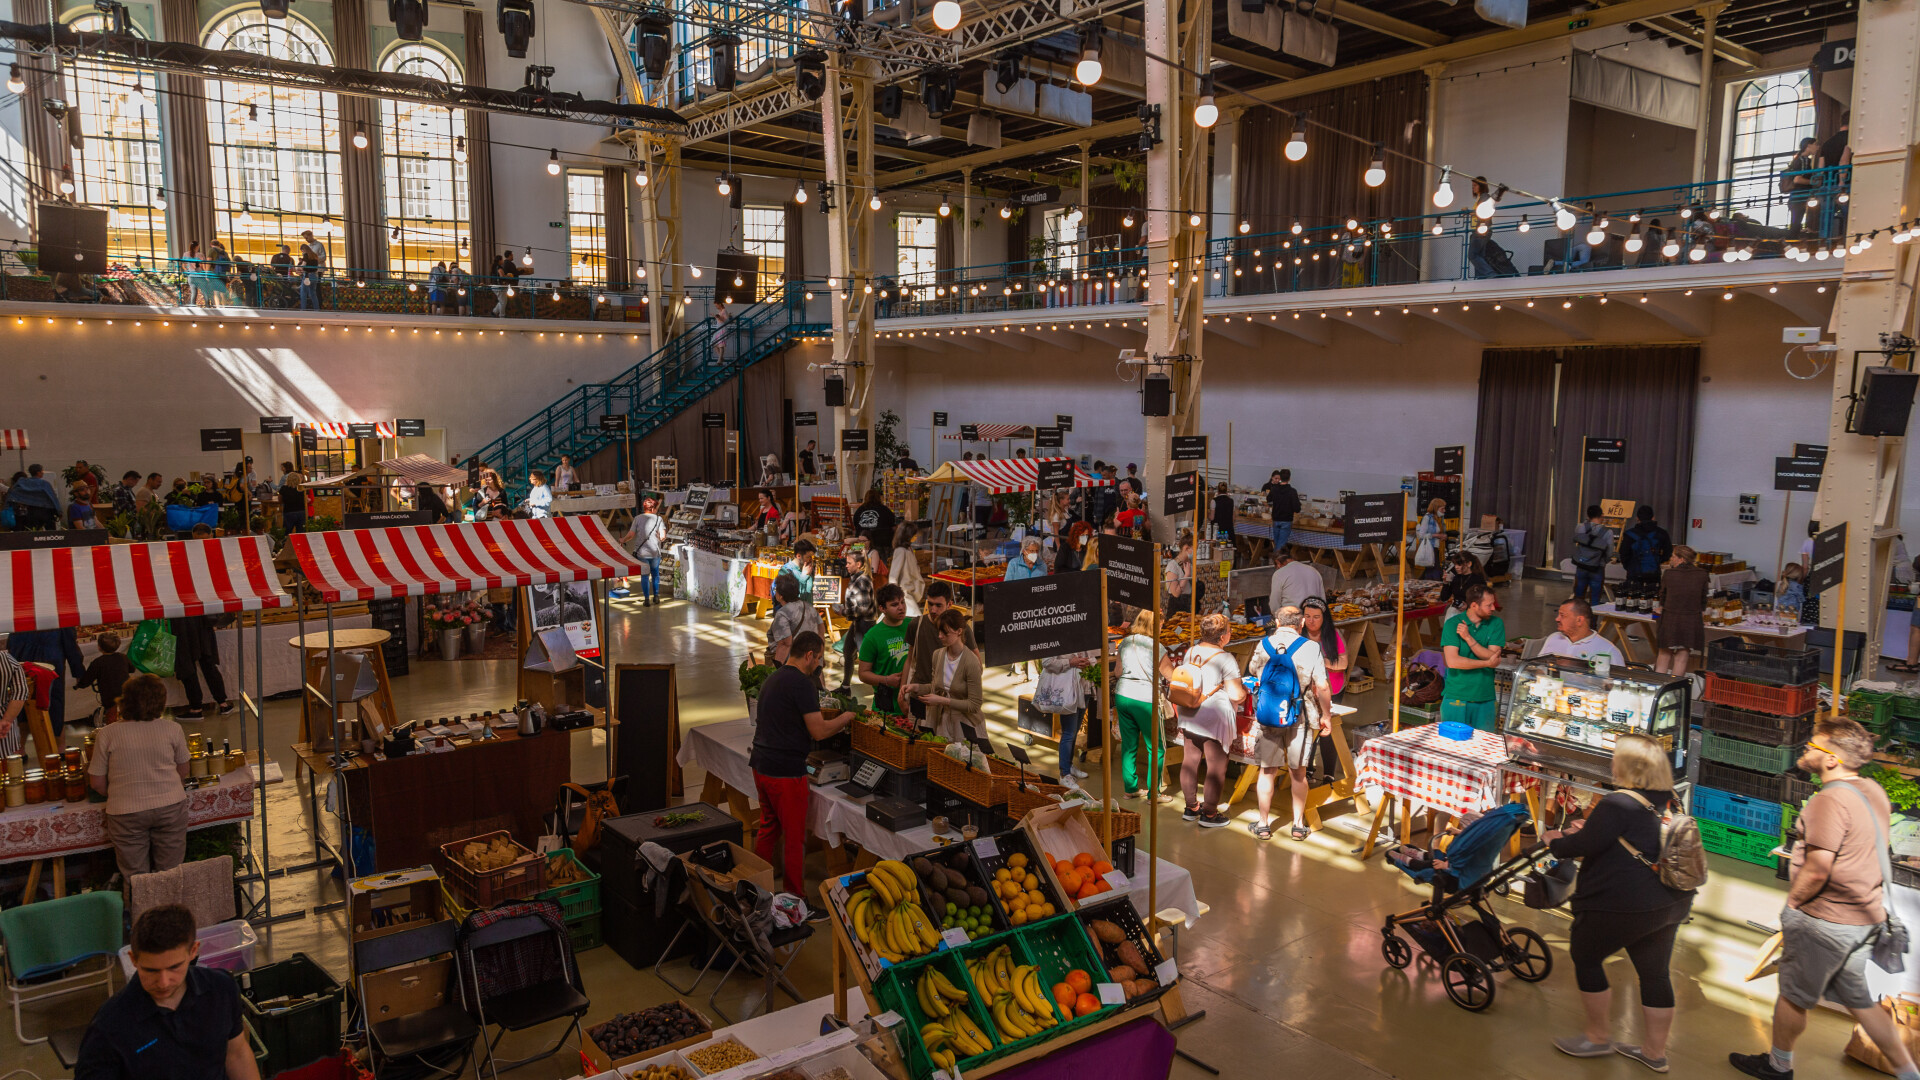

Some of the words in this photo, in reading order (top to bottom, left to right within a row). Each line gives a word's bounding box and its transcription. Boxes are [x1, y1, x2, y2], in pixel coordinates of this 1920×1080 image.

[1608, 507, 1623, 516] MED
[1012, 606, 1047, 620] EXOTICKÉ
[1047, 603, 1076, 616] OVOCIE
[1000, 624, 1007, 633] A
[1007, 617, 1051, 632] ORIENTÁLNE
[1051, 612, 1088, 626] KORENINY
[1030, 641, 1060, 651] BRATISLAVA
